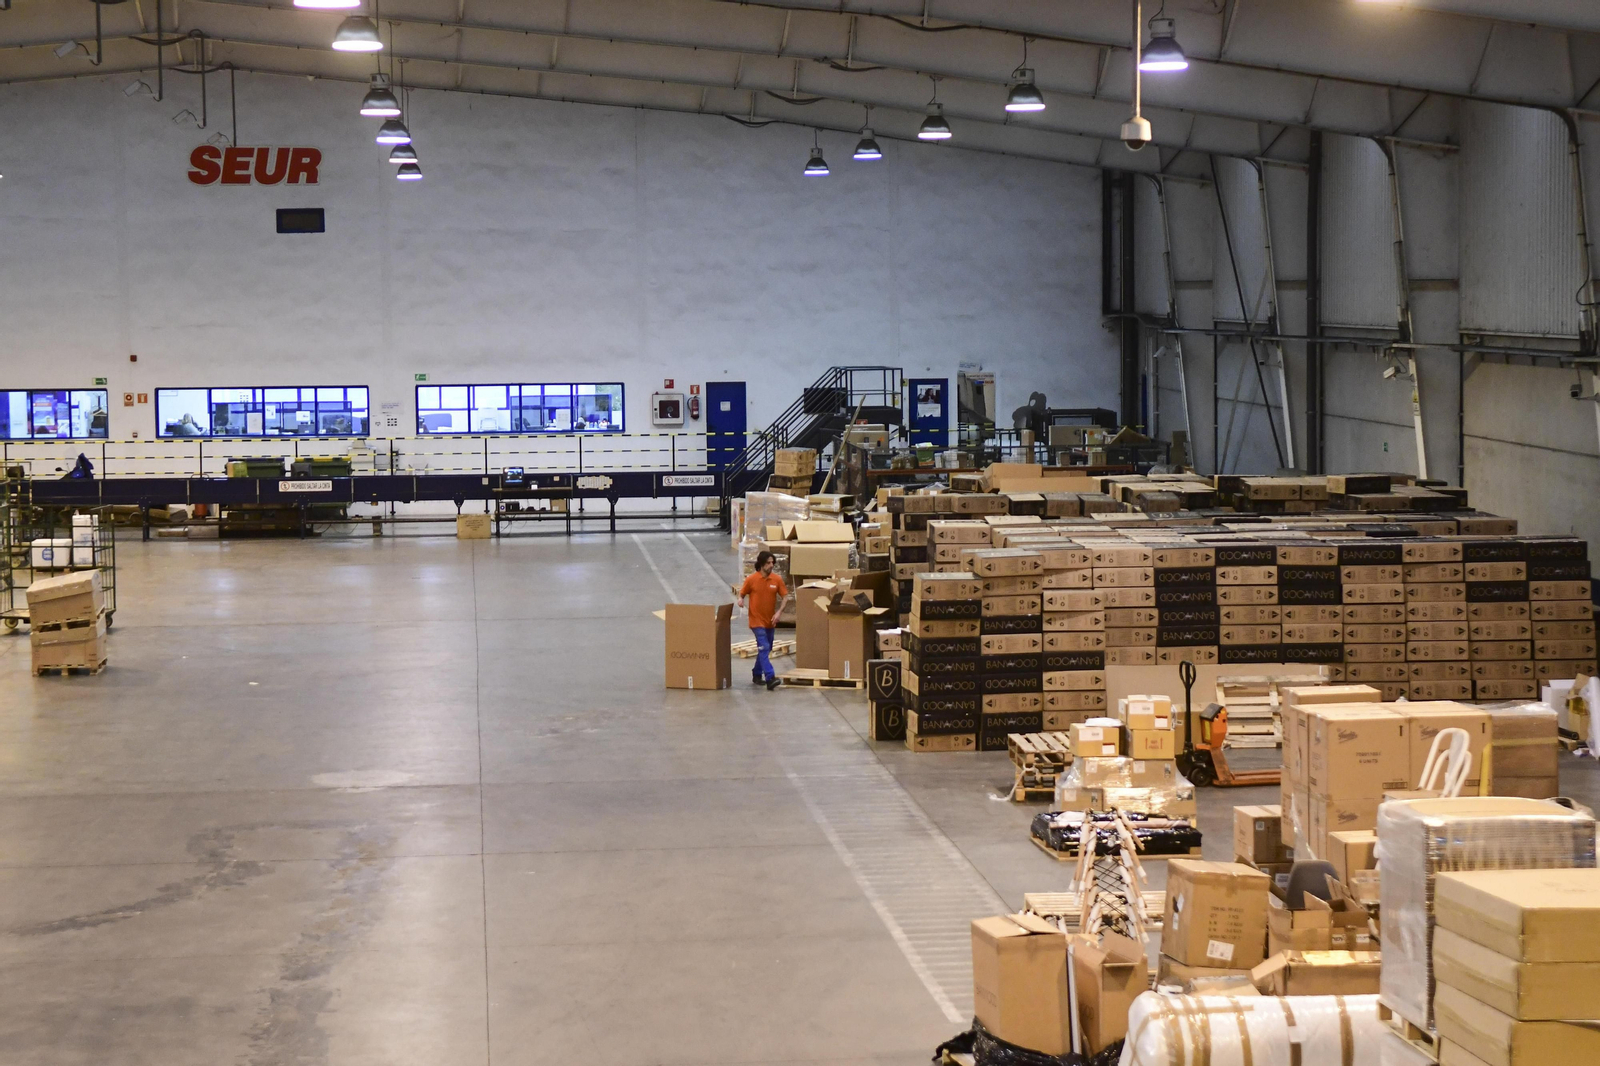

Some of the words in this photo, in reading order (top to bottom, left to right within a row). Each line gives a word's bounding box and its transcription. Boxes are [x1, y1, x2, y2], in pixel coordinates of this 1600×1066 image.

[188, 145, 322, 185] SEUR
[1219, 550, 1272, 560] BANWOOD
[1342, 550, 1395, 560] BANWOOD
[1469, 547, 1520, 557] BANWOOD
[1159, 572, 1211, 582] BANWOOD
[1282, 570, 1335, 580] BANWOOD
[1160, 592, 1212, 602] BANWOOD
[1282, 590, 1335, 599] BANWOOD
[1471, 587, 1524, 597] BANWOOD
[925, 604, 978, 614] BANWOOD
[1163, 611, 1215, 621] BANWOOD
[984, 619, 1037, 629] BANWOOD
[1162, 630, 1216, 640] BANWOOD
[924, 642, 977, 652] BANWOOD
[671, 651, 709, 660] BANWOOD
[1225, 650, 1278, 659] BANWOOD
[1286, 649, 1339, 658] BANWOOD
[985, 658, 1038, 668] BANWOOD
[1047, 656, 1100, 666] BANWOOD
[922, 662, 975, 672] BANWOOD
[881, 669, 893, 687] B
[985, 678, 1037, 688] BANWOOD
[923, 681, 976, 691] BANWOOD
[922, 700, 976, 710] BANWOOD
[888, 709, 899, 727] B
[987, 716, 1039, 726] BANWOOD
[922, 719, 975, 729] BANWOOD
